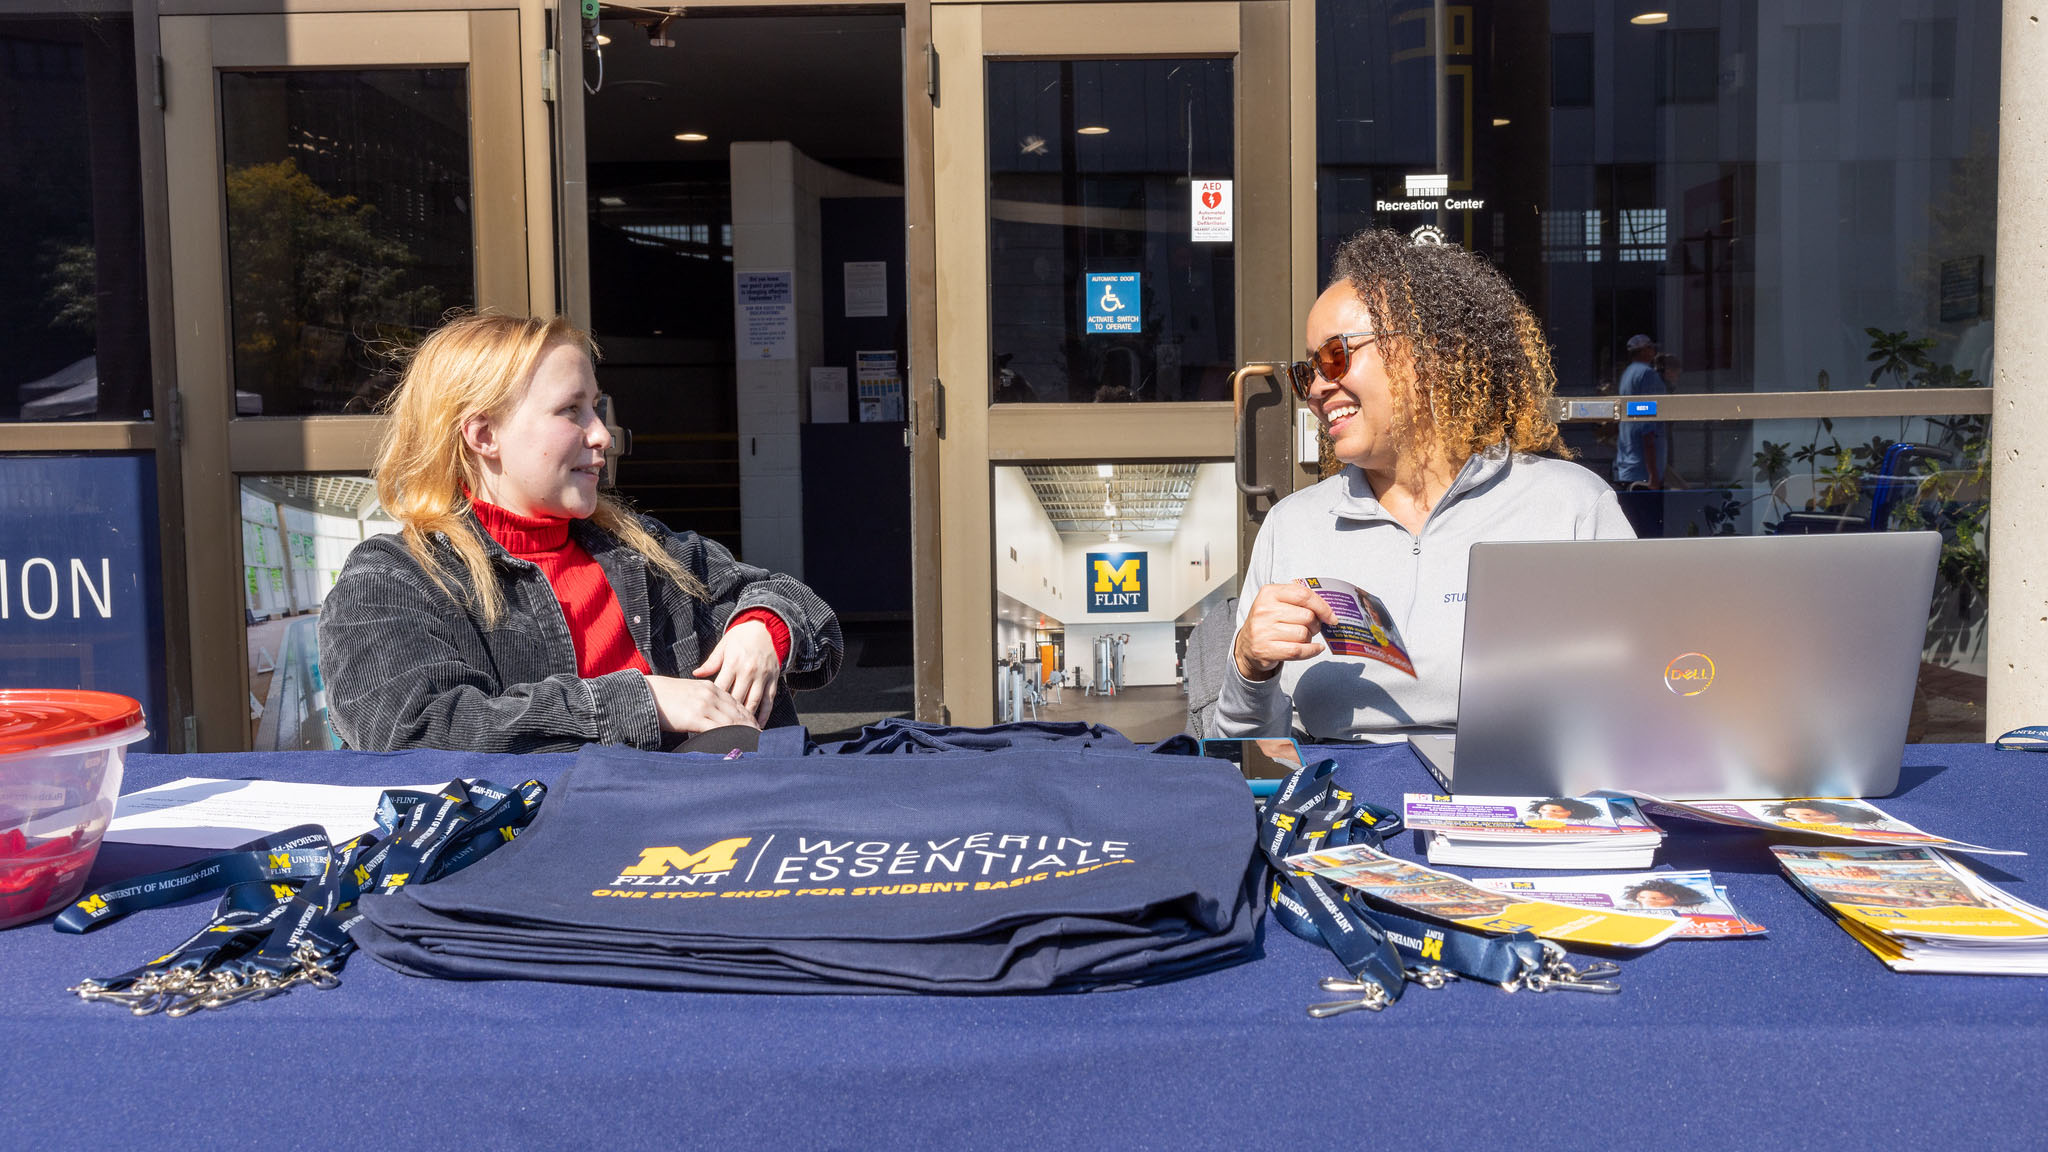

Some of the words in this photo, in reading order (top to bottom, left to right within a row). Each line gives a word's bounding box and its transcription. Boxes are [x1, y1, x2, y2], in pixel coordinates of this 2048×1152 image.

[1202, 182, 1222, 191] AED
[1376, 200, 1439, 211] Recreation
[1444, 199, 1484, 210] Center
[1088, 315, 1114, 323] ACTIVATE
[1116, 315, 1139, 323] SWITCH
[1094, 559, 1140, 592] M
[1095, 593, 1141, 605] FLINT
[1671, 668, 1708, 681] DELL
[1276, 813, 1296, 832] M
[798, 833, 1129, 855] WOLVERINE
[268, 853, 292, 870] M
[620, 837, 752, 876] M
[270, 867, 293, 876] FLINT
[354, 863, 371, 886] M
[773, 850, 1126, 884] ESSENTIAL
[591, 889, 648, 898] ONE
[650, 891, 717, 899] STOP
[720, 889, 791, 899] SHOP
[795, 887, 846, 897] FOR
[850, 882, 968, 897] STUDENT
[974, 872, 1049, 891] BASIC
[609, 871, 731, 886] FLINT
[77, 893, 108, 915] M
[101, 885, 143, 903] UNIVERSITY
[144, 881, 158, 894] OF
[158, 864, 221, 891] MICHIGAN-FLINT
[271, 884, 296, 900] M
[90, 905, 111, 919] FLINT
[1424, 929, 1445, 941] FLINT
[1421, 936, 1444, 962] M
